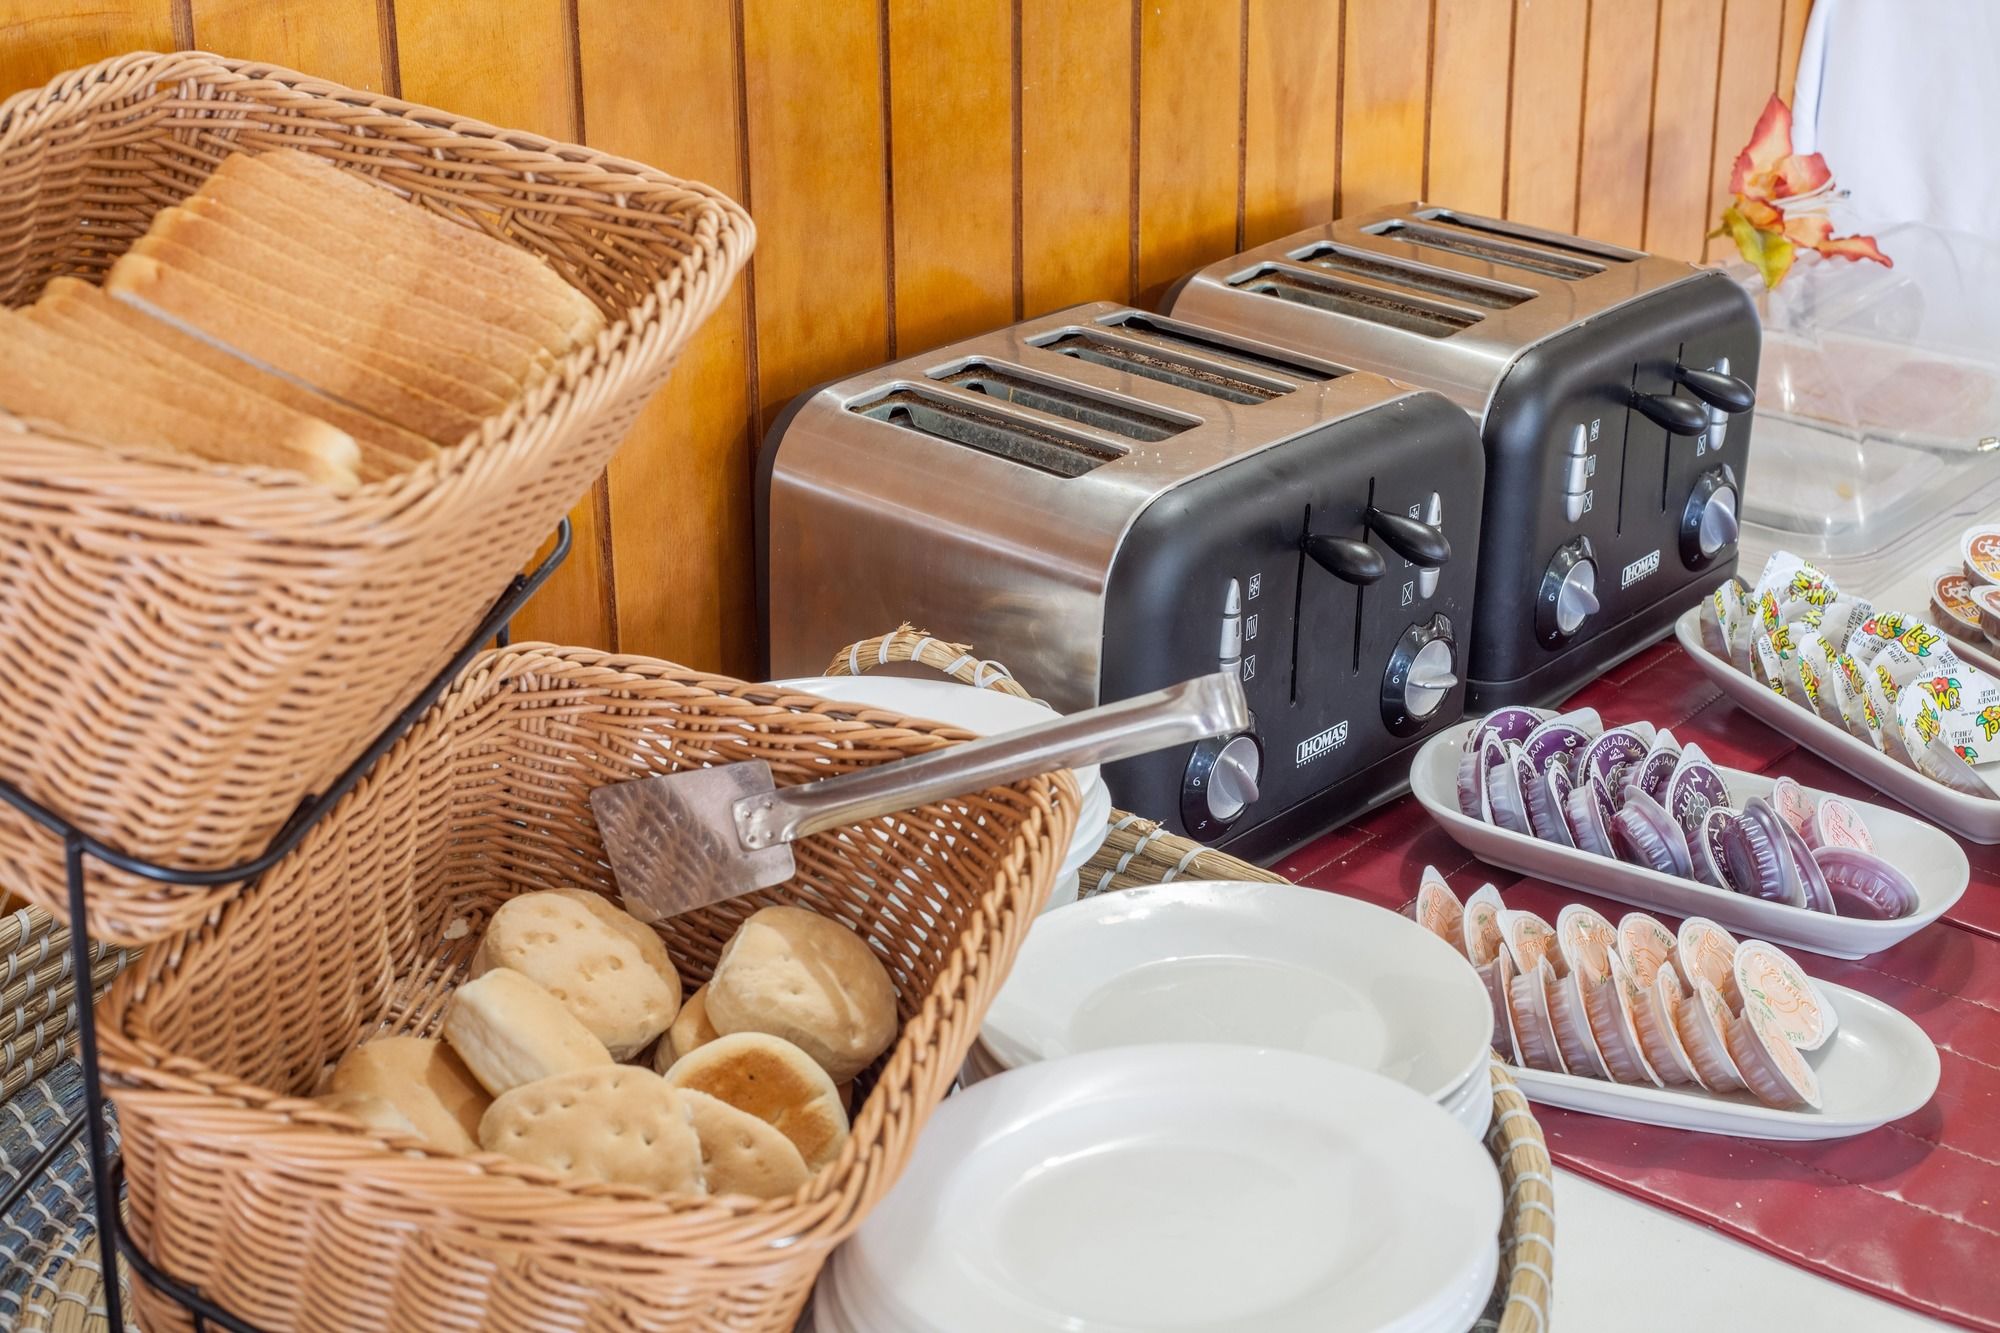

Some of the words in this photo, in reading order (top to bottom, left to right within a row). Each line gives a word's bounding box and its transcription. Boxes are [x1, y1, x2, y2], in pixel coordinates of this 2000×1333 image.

[1626, 553, 1658, 579] THOMAS
[1548, 593, 1556, 602] 6
[1412, 631, 1419, 642] 7
[1392, 675, 1400, 684] 6
[1301, 724, 1346, 759] THOMAS
[1193, 777, 1201, 787] 6
[1198, 820, 1208, 830] 5
